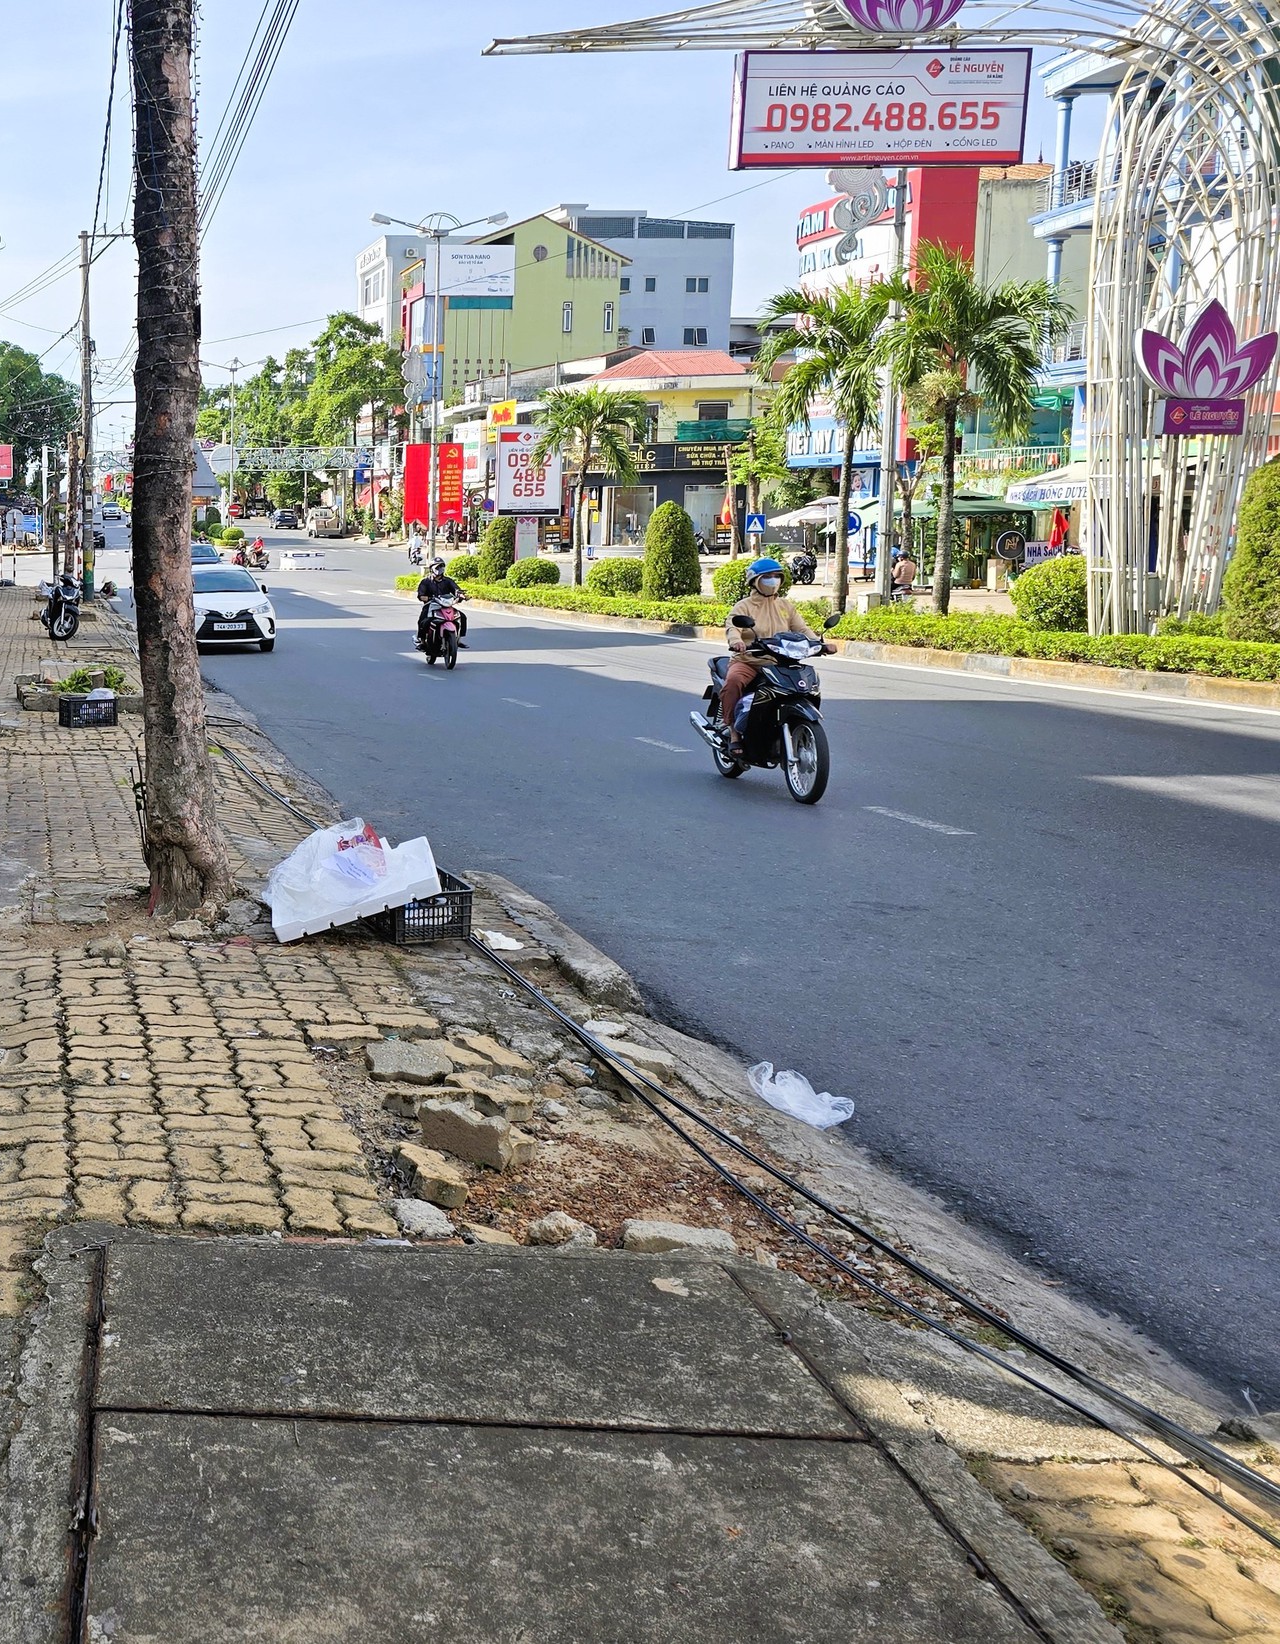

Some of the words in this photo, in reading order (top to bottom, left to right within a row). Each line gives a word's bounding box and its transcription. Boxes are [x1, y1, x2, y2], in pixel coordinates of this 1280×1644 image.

[949, 62, 961, 73] LÊ
[963, 60, 1005, 73] NGUYỄN
[768, 83, 797, 97] LIÊN
[800, 84, 818, 99] HỆ
[821, 83, 872, 96] QUẢNG
[875, 82, 906, 96] CÁO
[766, 101, 1001, 132] 0982.488.655
[770, 140, 795, 149] PANO
[814, 138, 835, 149] MÀN
[835, 138, 857, 149] HÌNH
[858, 140, 874, 149] LED
[893, 138, 912, 150] HỘP
[914, 137, 933, 149] ĐÈN
[981, 139, 998, 147] LED
[840, 154, 919, 162] www.artlenguyen.com.vn
[508, 453, 552, 468] 092
[513, 468, 546, 482] 488
[513, 483, 545, 497] 655
[1027, 544, 1042, 557] NHÀ
